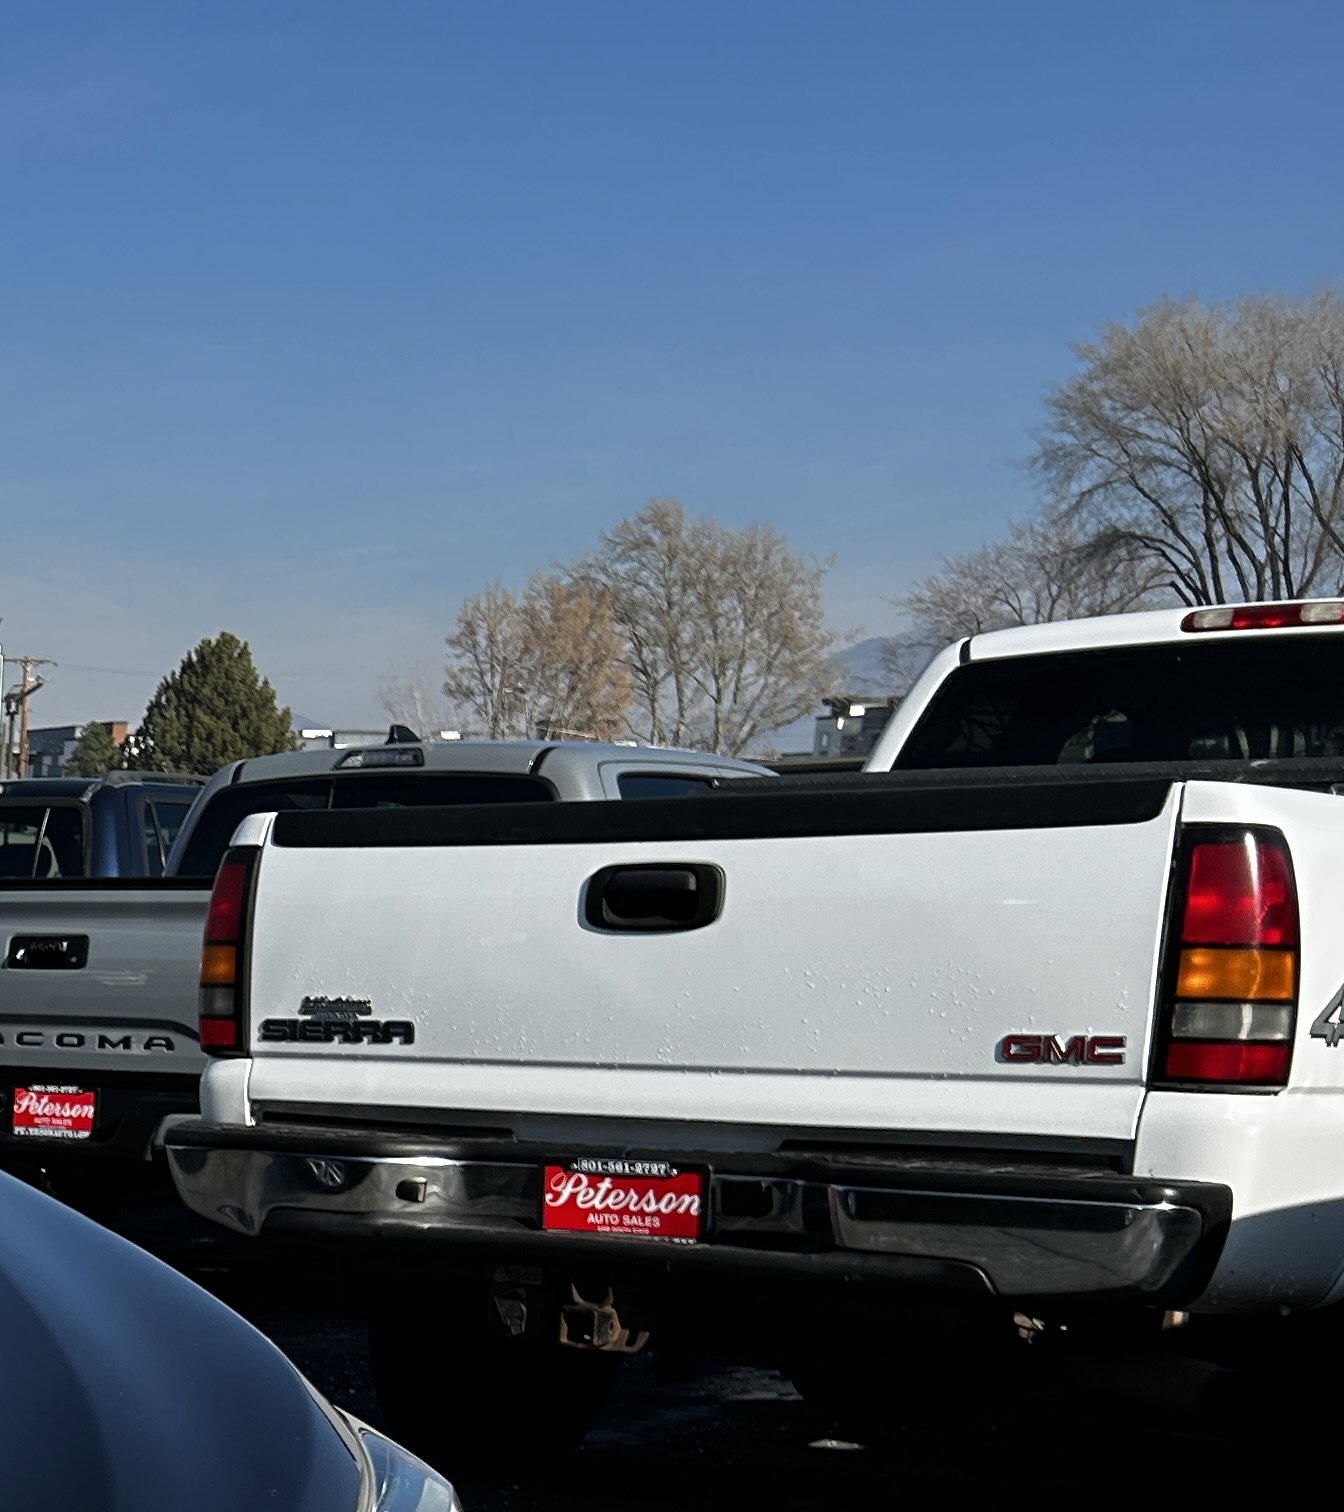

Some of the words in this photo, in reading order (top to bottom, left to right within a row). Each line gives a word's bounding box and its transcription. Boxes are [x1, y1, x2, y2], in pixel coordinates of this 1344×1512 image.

[258, 1018, 415, 1045] SIERRA
[1002, 1034, 1128, 1064] GMC
[13, 1091, 95, 1119] Peterson
[544, 1172, 702, 1216] Peterson
[587, 1212, 619, 1225] AUTO
[622, 1214, 661, 1228] SALES
